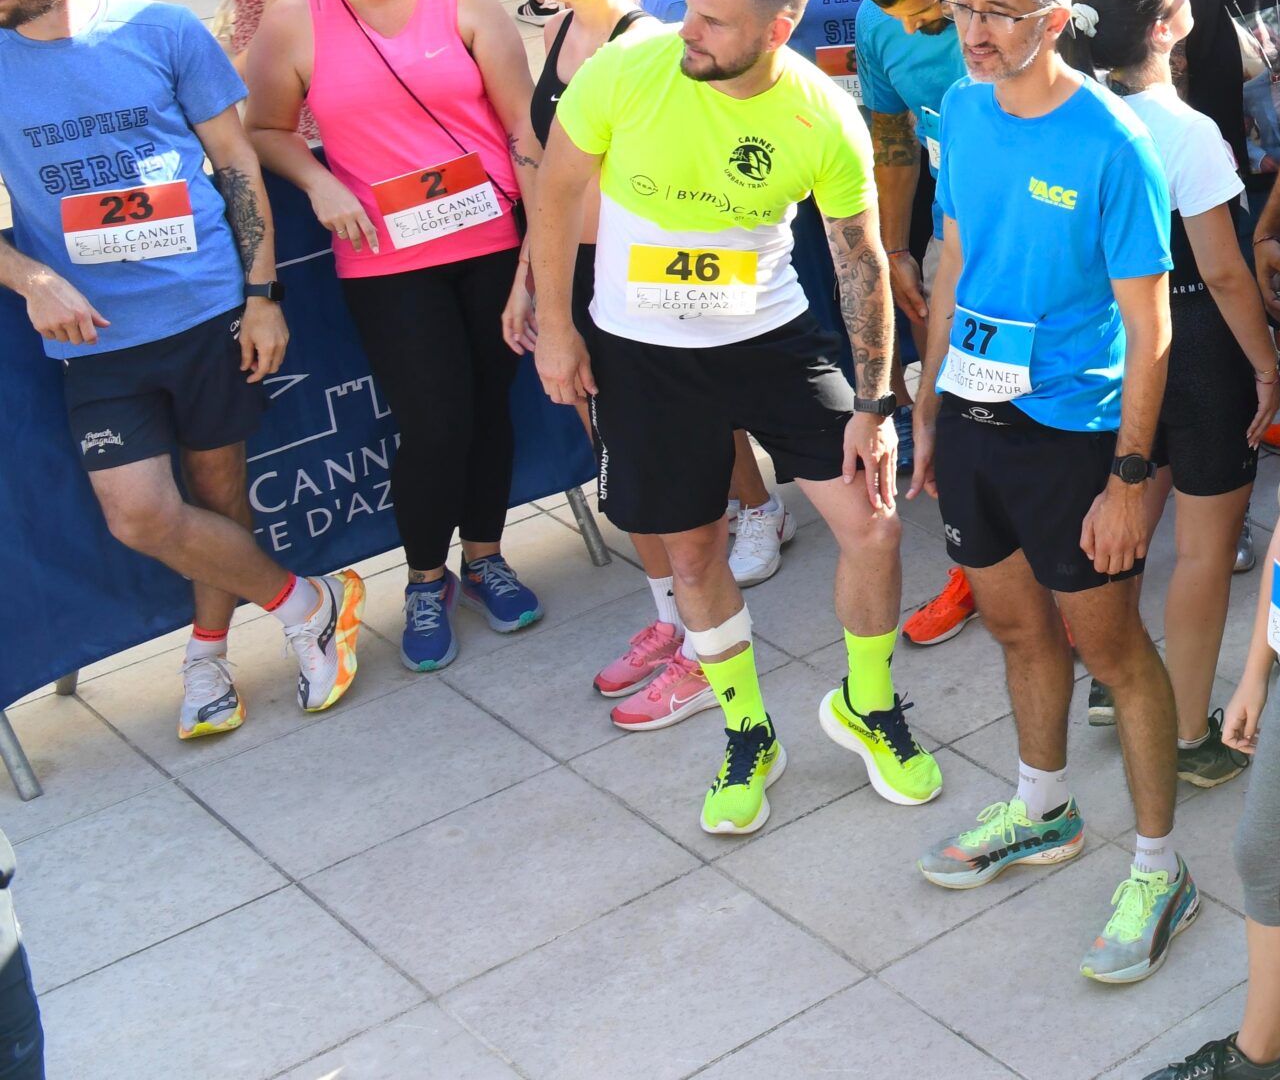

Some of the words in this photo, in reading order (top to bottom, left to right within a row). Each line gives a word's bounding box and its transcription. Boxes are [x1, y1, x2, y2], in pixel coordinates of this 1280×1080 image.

[23, 106, 149, 148] TROPHEE
[739, 135, 776, 153] CANNES
[39, 142, 156, 195] SERGE
[723, 168, 746, 189] URBAN
[747, 180, 769, 190] TRAIL
[421, 170, 448, 199] 2
[100, 191, 154, 225] 23
[419, 208, 433, 221] LE
[437, 191, 487, 216] CANNET
[451, 201, 493, 225] D'AZUR
[103, 233, 119, 245] LE
[126, 223, 184, 242] CANNET
[142, 235, 187, 250] D'AZUR
[665, 251, 720, 282] 46
[665, 289, 680, 301] LE
[962, 318, 998, 355] 27
[968, 362, 1019, 385] CANNET
[977, 381, 1022, 395] D'AZUR
[600, 442, 610, 500] ARMOUR
